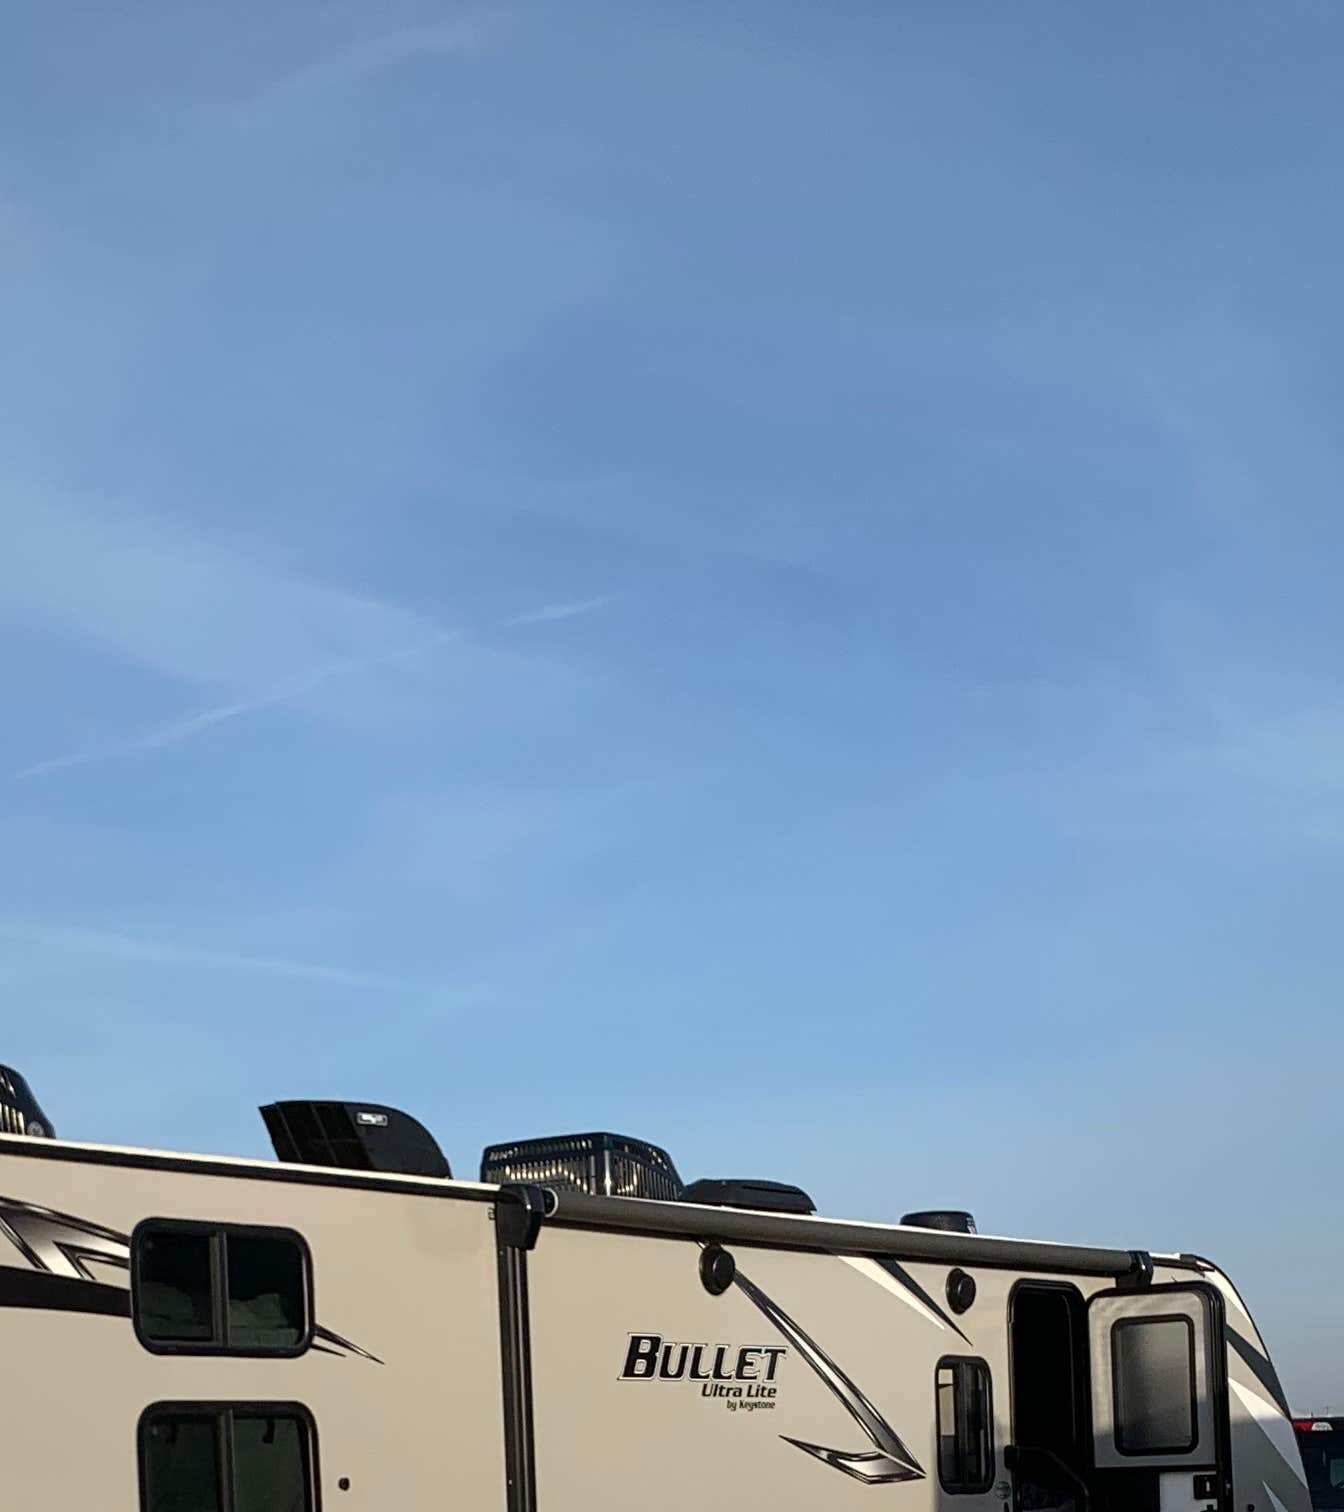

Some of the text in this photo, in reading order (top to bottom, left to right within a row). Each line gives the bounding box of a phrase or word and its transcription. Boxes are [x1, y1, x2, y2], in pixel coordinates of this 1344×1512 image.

[617, 1332, 788, 1383] BULLET
[701, 1383, 776, 1398] Ultra Lite
[726, 1400, 776, 1411] by Keystone
